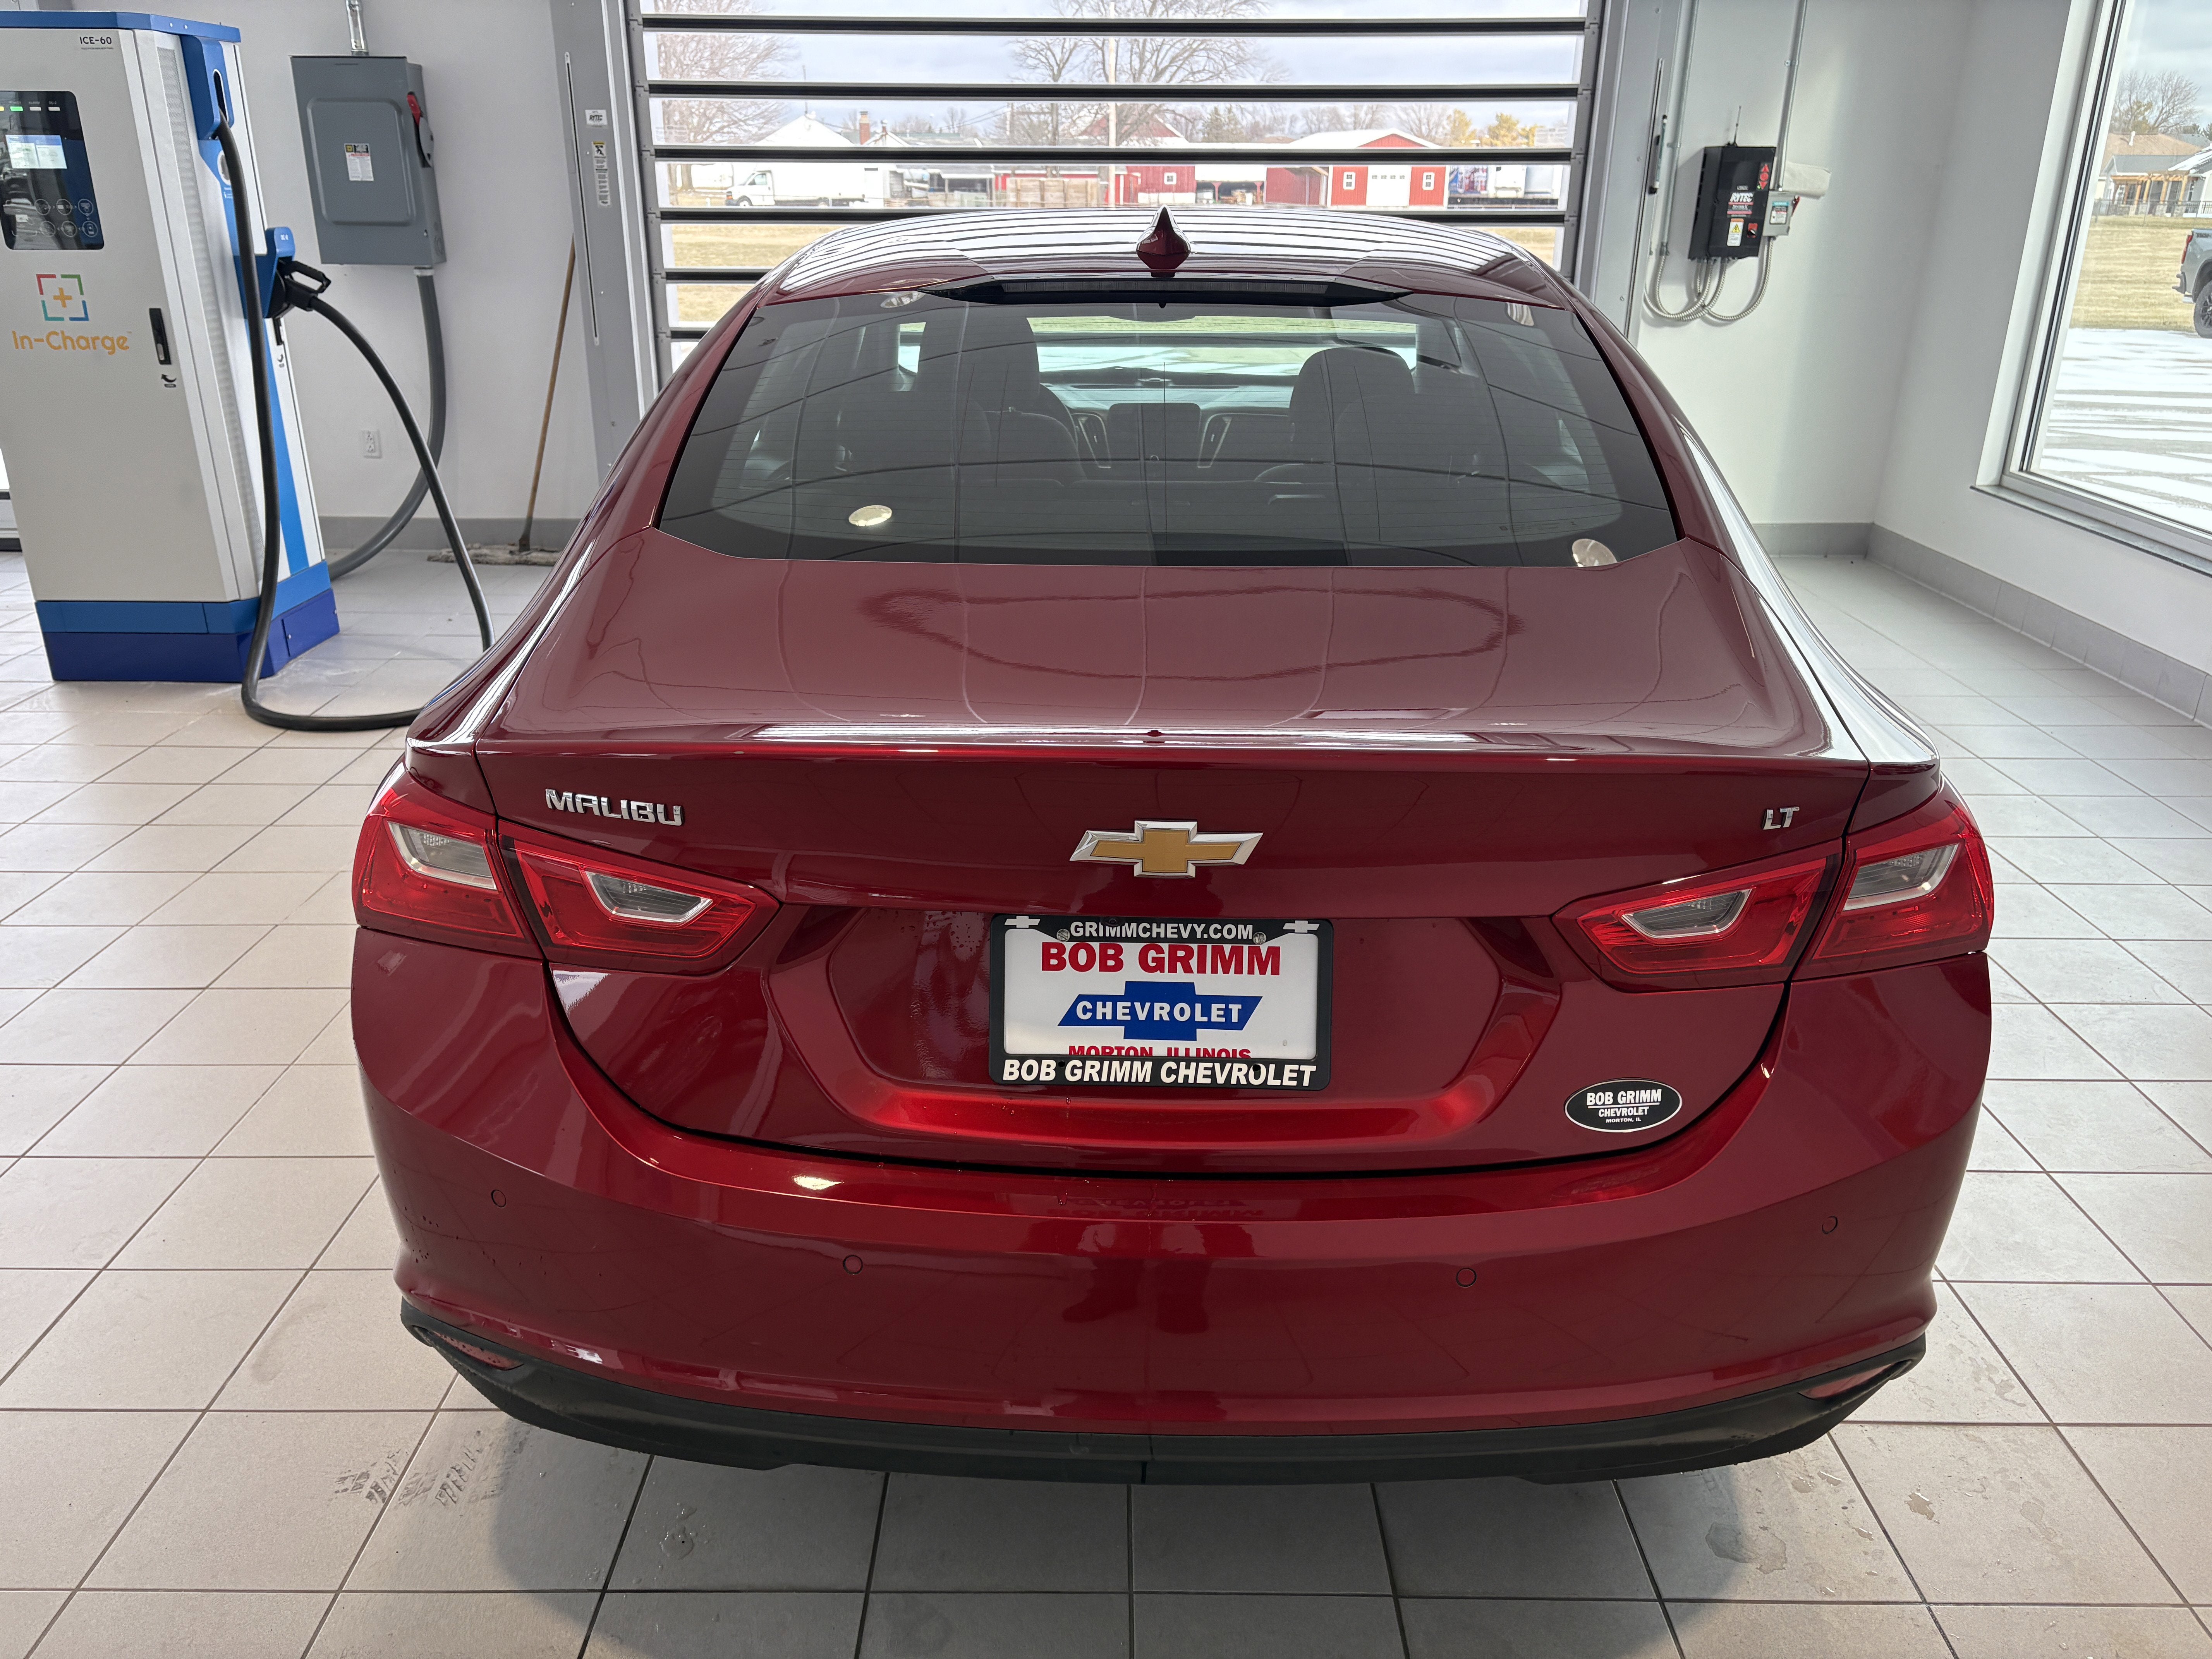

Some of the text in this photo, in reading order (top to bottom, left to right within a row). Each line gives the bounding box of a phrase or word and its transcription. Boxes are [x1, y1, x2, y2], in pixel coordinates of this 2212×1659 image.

[12, 330, 129, 356] In-Charge
[545, 788, 682, 826] MALIBU
[1763, 806, 1800, 830] LT
[1070, 922, 1253, 939] GRIMMCHEVY.COM
[1042, 942, 1281, 975] BOB GRIMM
[1076, 1001, 1242, 1023] CHEVROLET
[1003, 1059, 1317, 1087] BOB GRIMM CHEVROLET
[1587, 1089, 1662, 1106] BOB GRIMM
[1598, 1106, 1649, 1117] CHEVROLET
